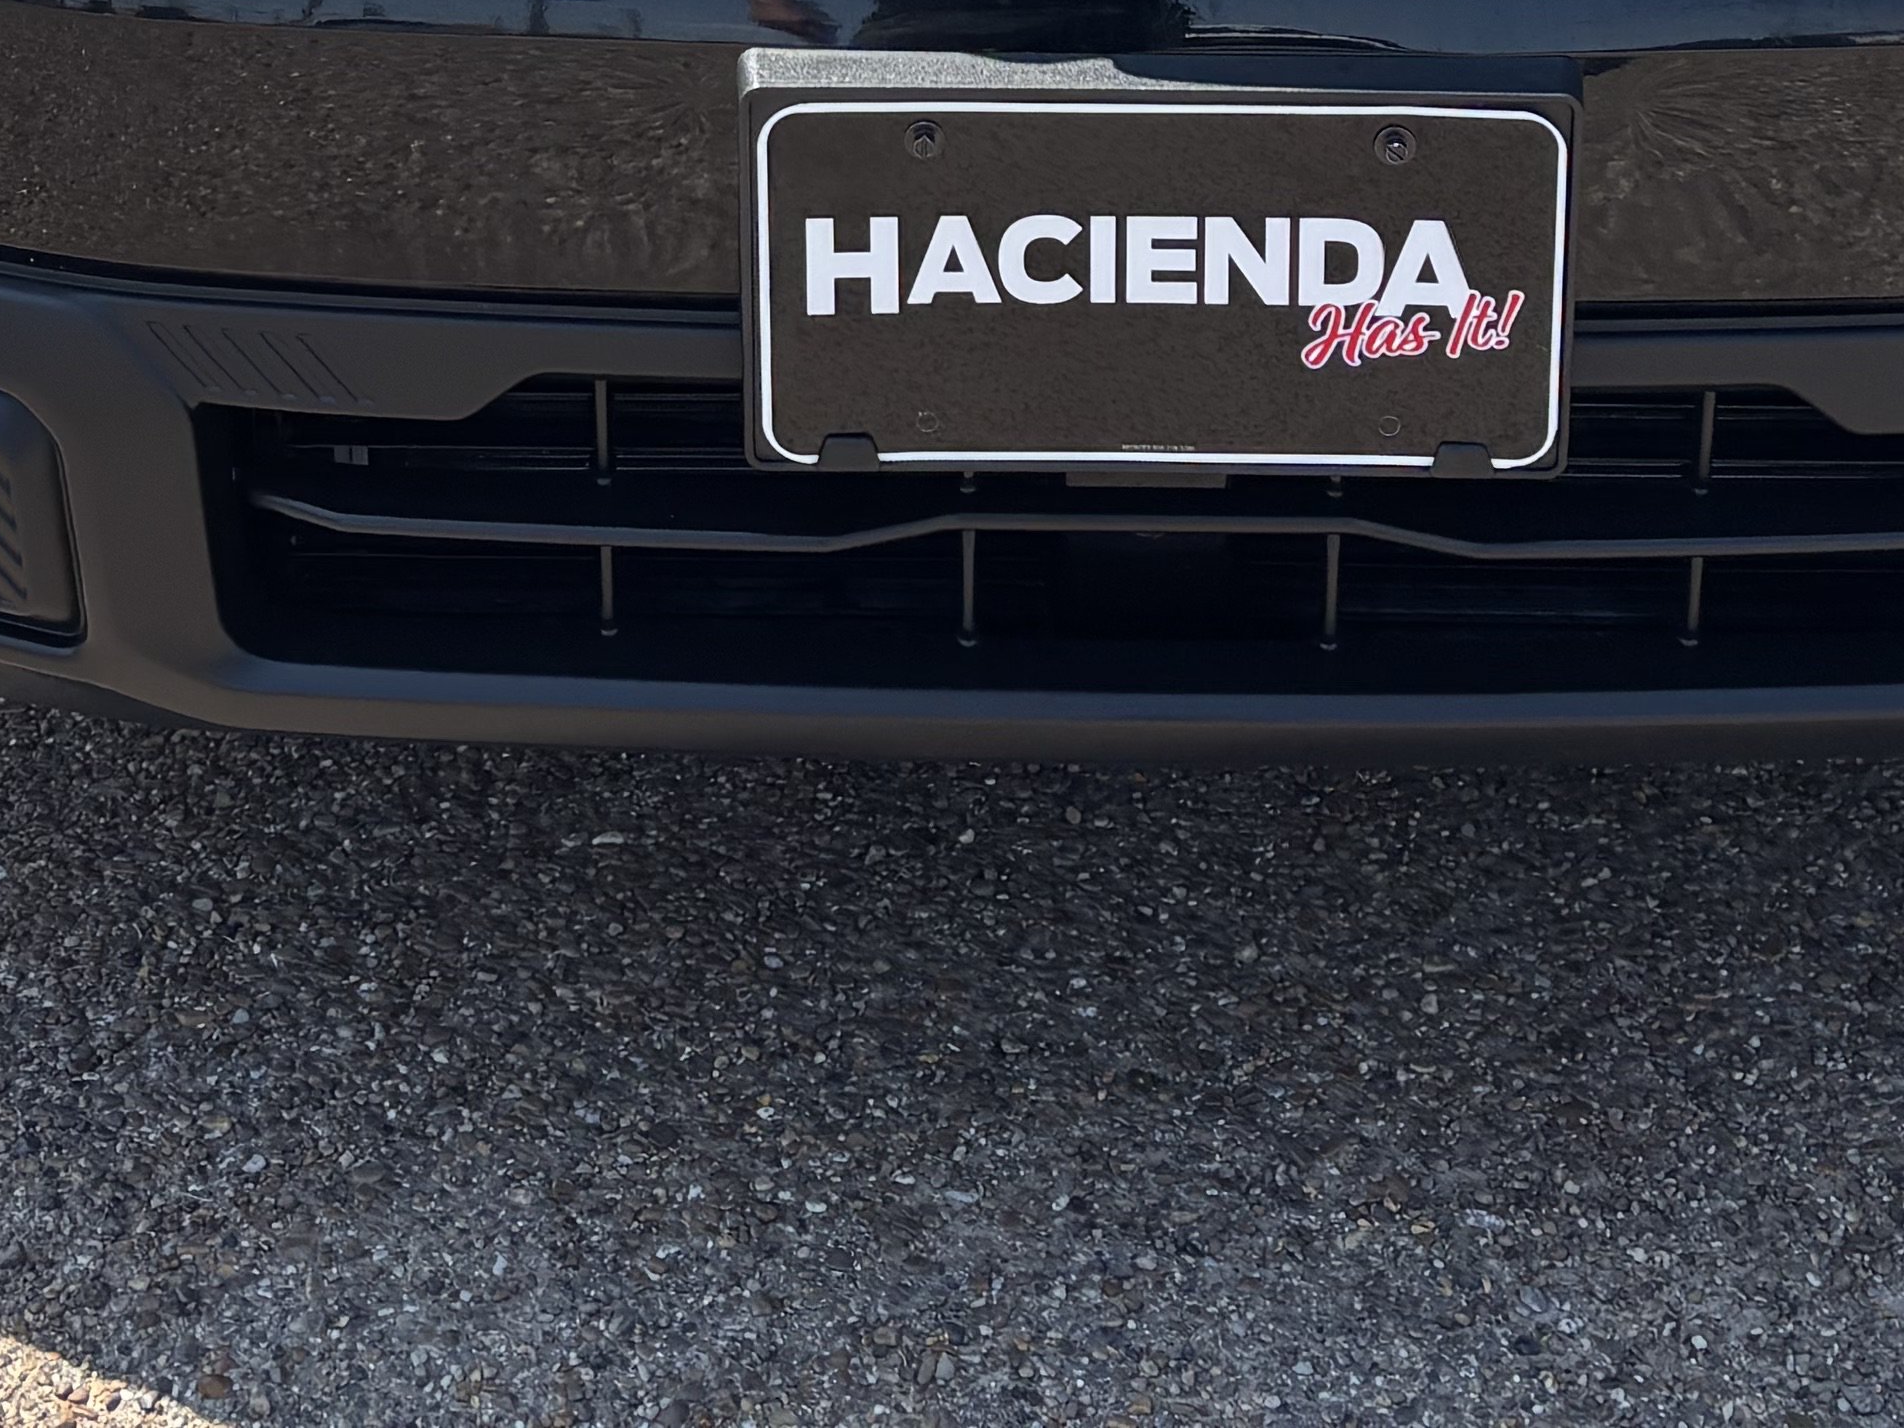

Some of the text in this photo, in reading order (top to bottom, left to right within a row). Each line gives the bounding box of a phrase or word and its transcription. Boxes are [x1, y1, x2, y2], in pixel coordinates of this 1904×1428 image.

[805, 214, 1472, 317] HACIENDA
[1301, 289, 1524, 369] Has It!
